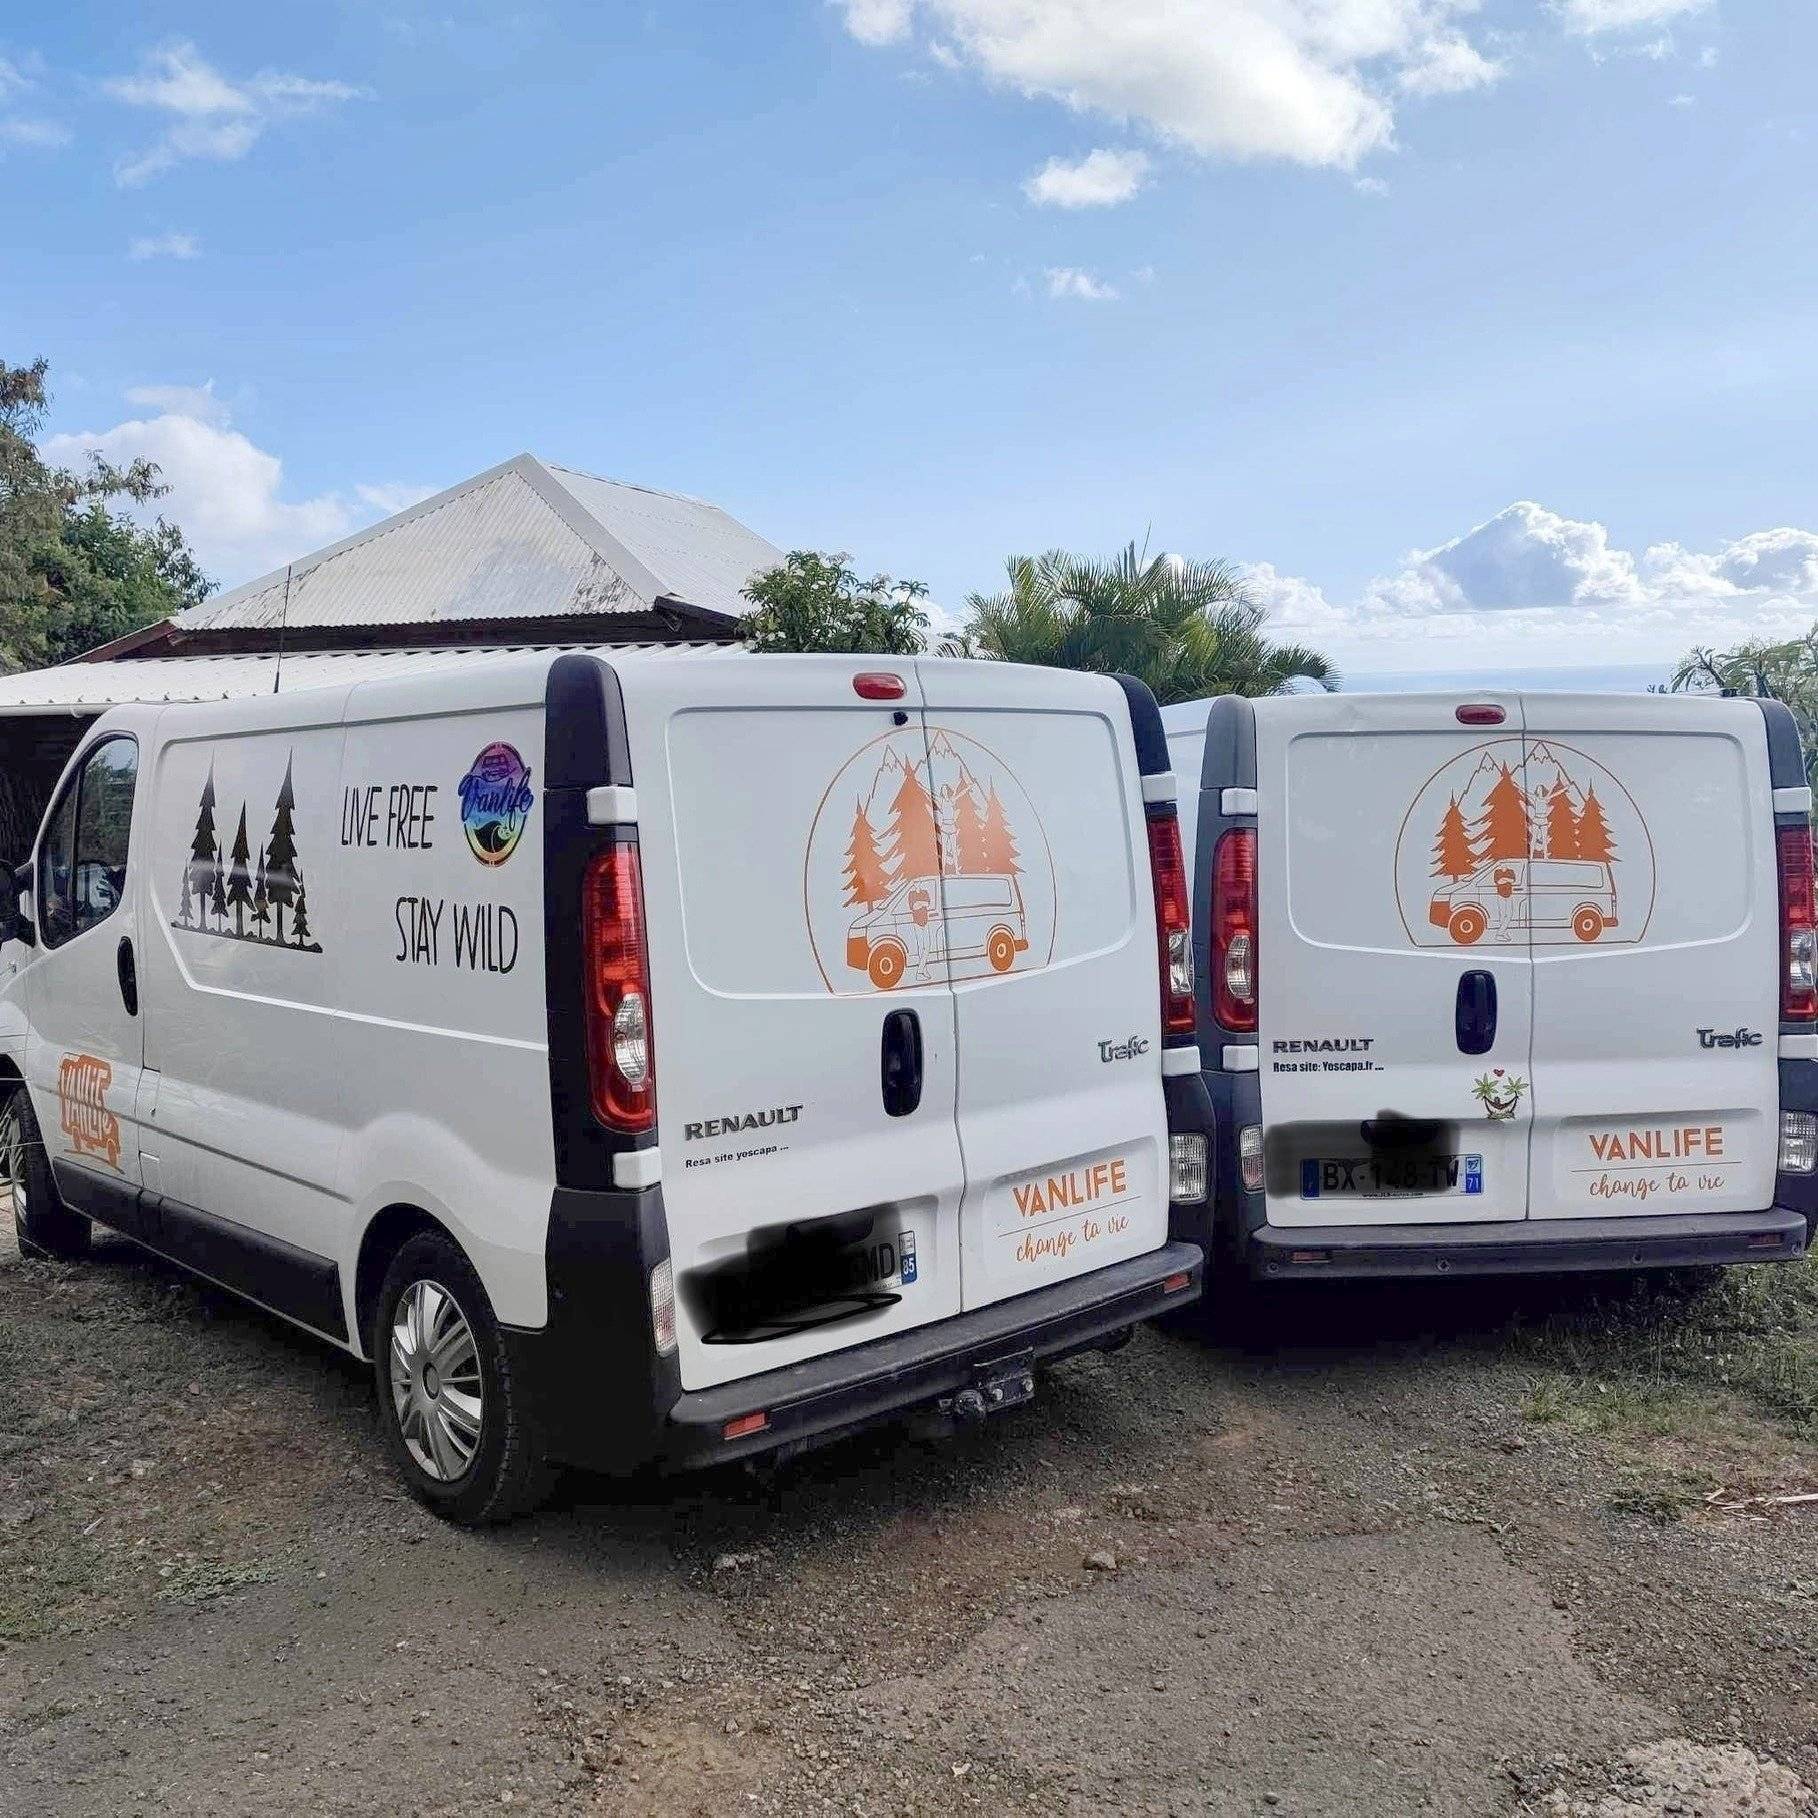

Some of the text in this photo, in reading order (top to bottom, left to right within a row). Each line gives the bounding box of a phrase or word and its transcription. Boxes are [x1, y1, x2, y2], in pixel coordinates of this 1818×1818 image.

[458, 766, 534, 831] Vanlife
[341, 784, 438, 850] LIVE FREE
[396, 896, 519, 974] STAY WILD
[1098, 1035, 1149, 1062] Trafic
[1272, 1038, 1374, 1053] RENAULT
[1696, 1027, 1763, 1049] Trafic
[684, 1104, 804, 1141] RENAULT
[1589, 1127, 1724, 1160] VANLIFE
[1012, 1159, 1127, 1217] VANLIFE
[1467, 1177, 1479, 1191] 71
[1589, 1171, 1726, 1200] change ta vie
[1016, 1215, 1130, 1262] change ta vie
[902, 1257, 915, 1275] 85
